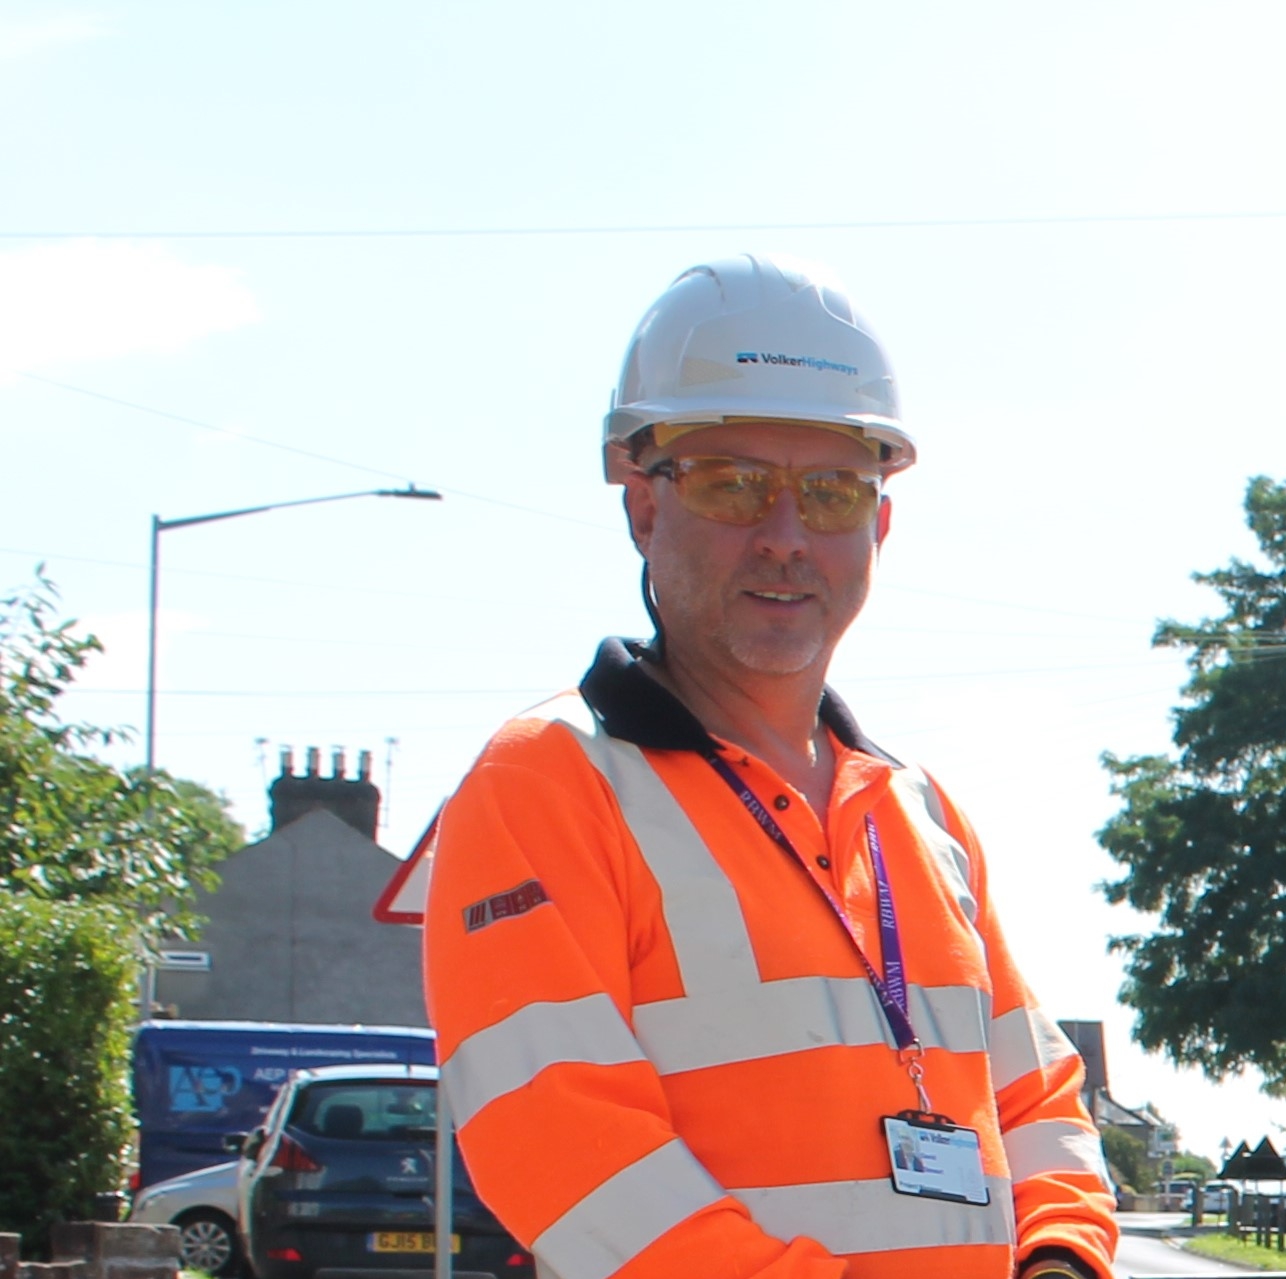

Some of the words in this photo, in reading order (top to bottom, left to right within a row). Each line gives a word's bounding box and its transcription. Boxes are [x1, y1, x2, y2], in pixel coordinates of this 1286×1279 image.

[761, 352, 859, 376] VolkerHighways
[878, 880, 895, 930] RBWM
[378, 1234, 417, 1248] GJ15
